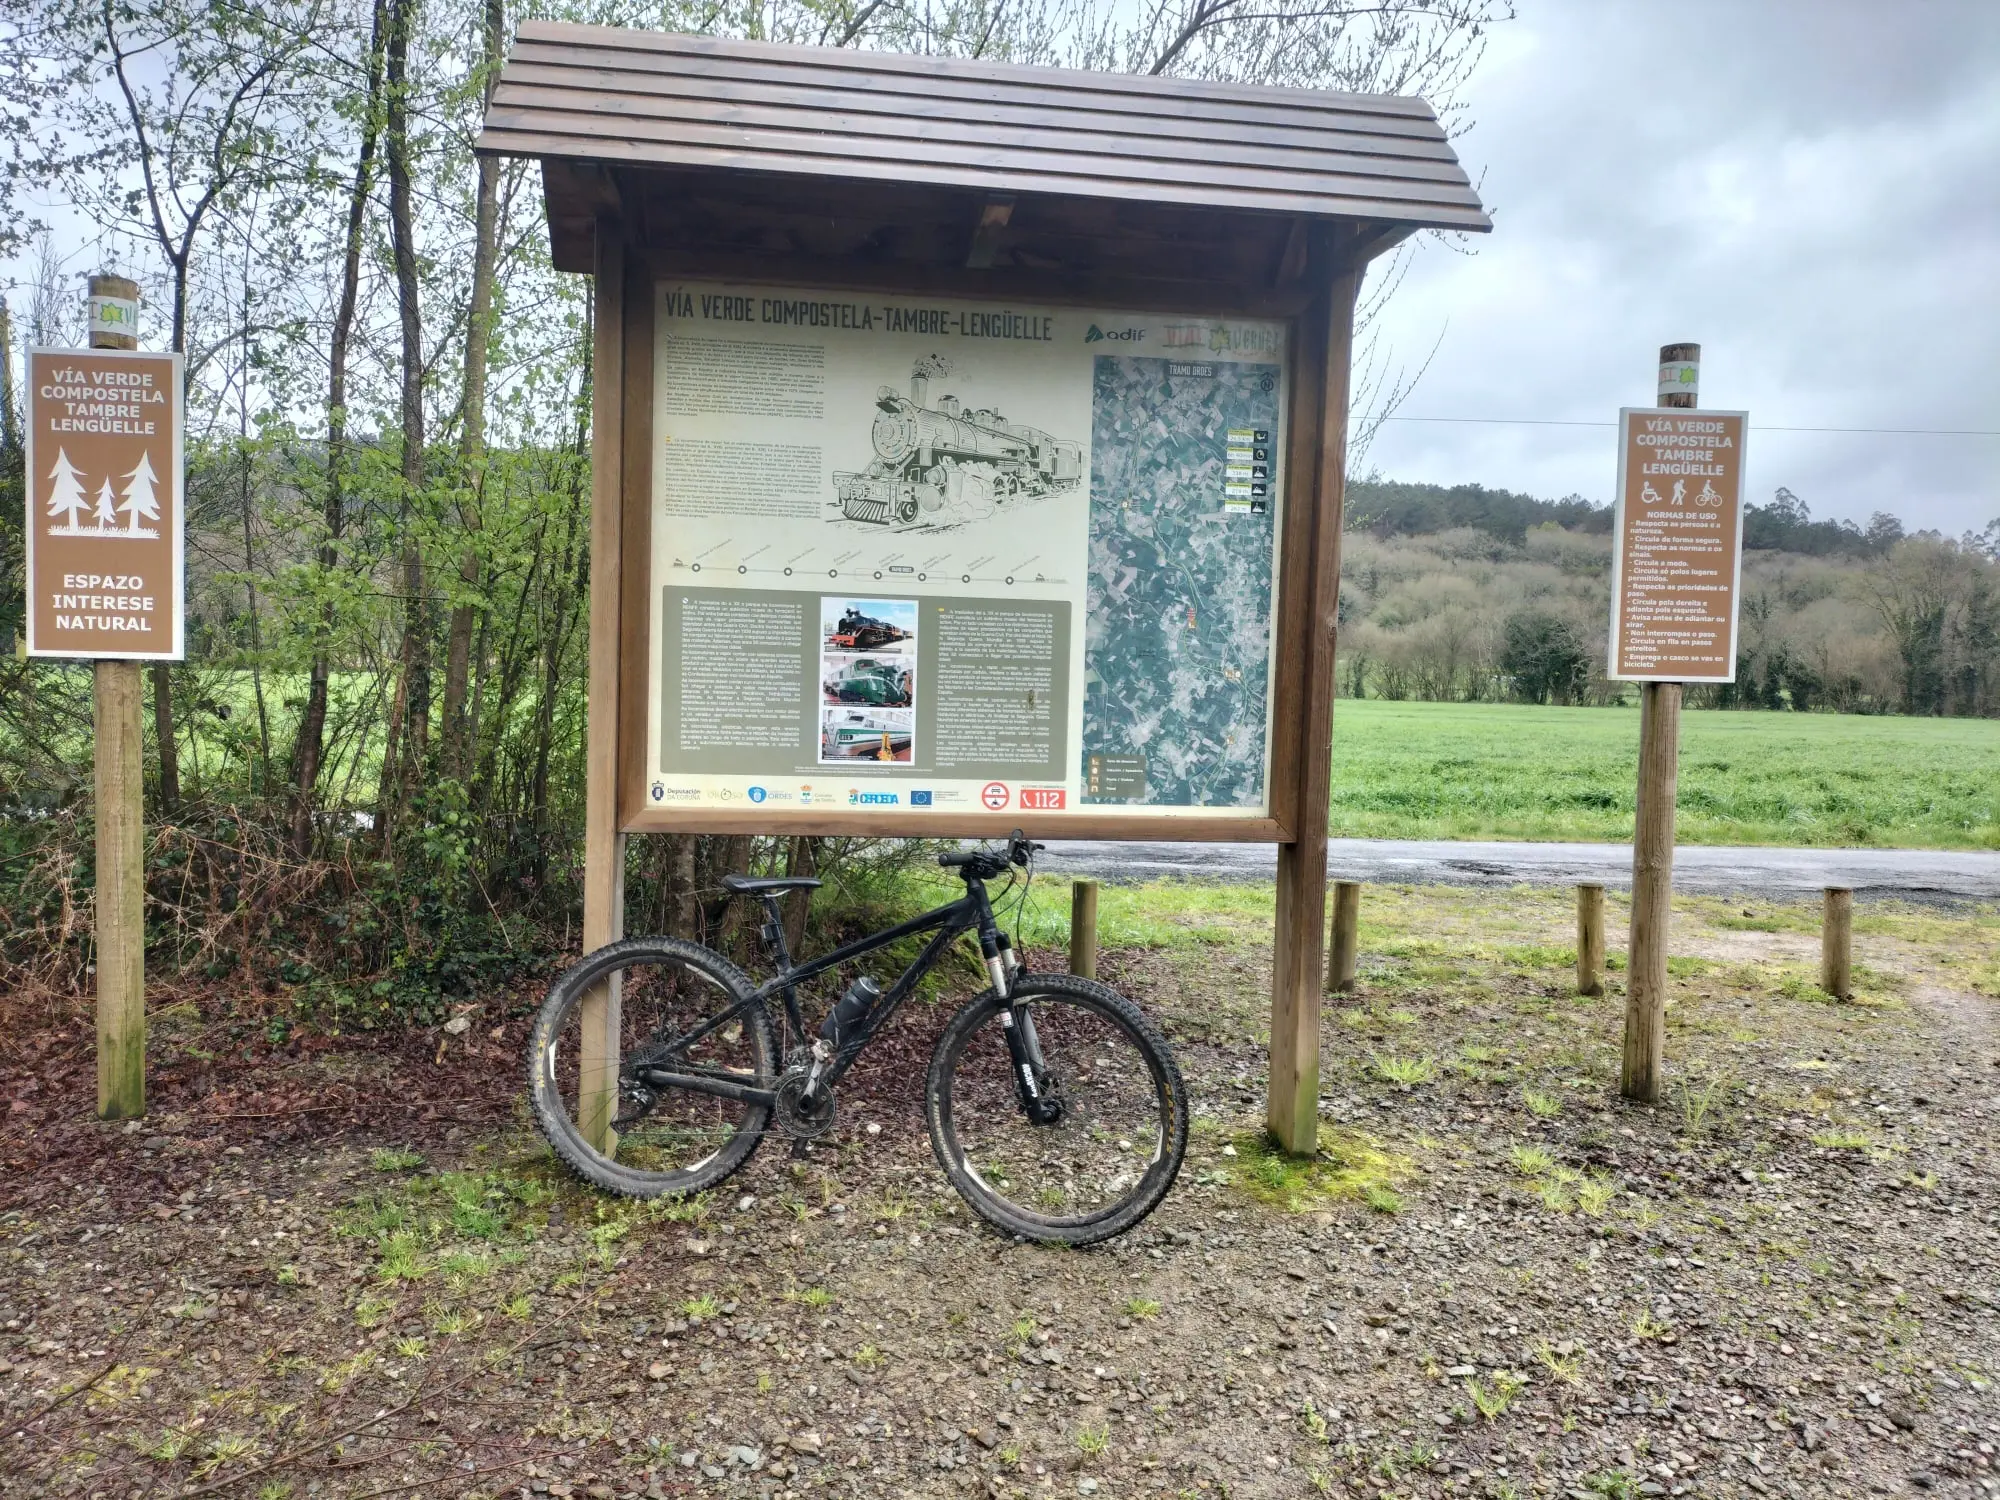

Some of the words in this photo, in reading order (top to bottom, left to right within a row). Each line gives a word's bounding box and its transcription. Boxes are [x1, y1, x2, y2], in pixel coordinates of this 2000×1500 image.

[665, 286, 693, 317] VÍA
[700, 293, 755, 321] VERDE
[1106, 328, 1146, 341] adif
[1169, 364, 1191, 375] TRAMO
[52, 366, 87, 384] VÍA
[92, 371, 154, 387] VERDE
[40, 385, 165, 403] COMPOSTELA
[64, 402, 140, 419] TAMBRE
[50, 416, 155, 435] LENGÜELLE
[1645, 416, 1673, 432] VÍA
[1676, 421, 1725, 433] VERDE
[1636, 434, 1733, 448] COMPOSTELA
[1654, 449, 1713, 462] TAMBRE
[1642, 461, 1725, 476] LENGÜELLE
[1647, 511, 1683, 520] NORMAS
[1685, 513, 1698, 521] DE
[1699, 513, 1718, 521] USO
[1634, 535, 1660, 543] Circula
[1696, 538, 1722, 546] segura.
[1634, 543, 1667, 552] Respecta
[1691, 568, 1718, 577] lugares
[63, 573, 144, 590] ESPAZO
[1627, 574, 1669, 583] permitidos.
[1632, 582, 1666, 591] Respecta
[1677, 583, 1718, 592] prioridades
[1626, 591, 1647, 599] paso.
[52, 593, 154, 611] INTERESE
[1631, 598, 1657, 606] Circula
[55, 615, 152, 632] NATURAL
[1631, 614, 1651, 622] Avisa
[1646, 630, 1691, 639] interrompas
[1667, 638, 1680, 646] fila
[1624, 645, 1659, 653] estreitos.
[1629, 653, 1662, 662] Emprega
[1623, 661, 1657, 669] bicicleta.
[667, 787, 701, 796] Deputación
[768, 792, 793, 800] ORDES
[1035, 792, 1060, 808] 112
